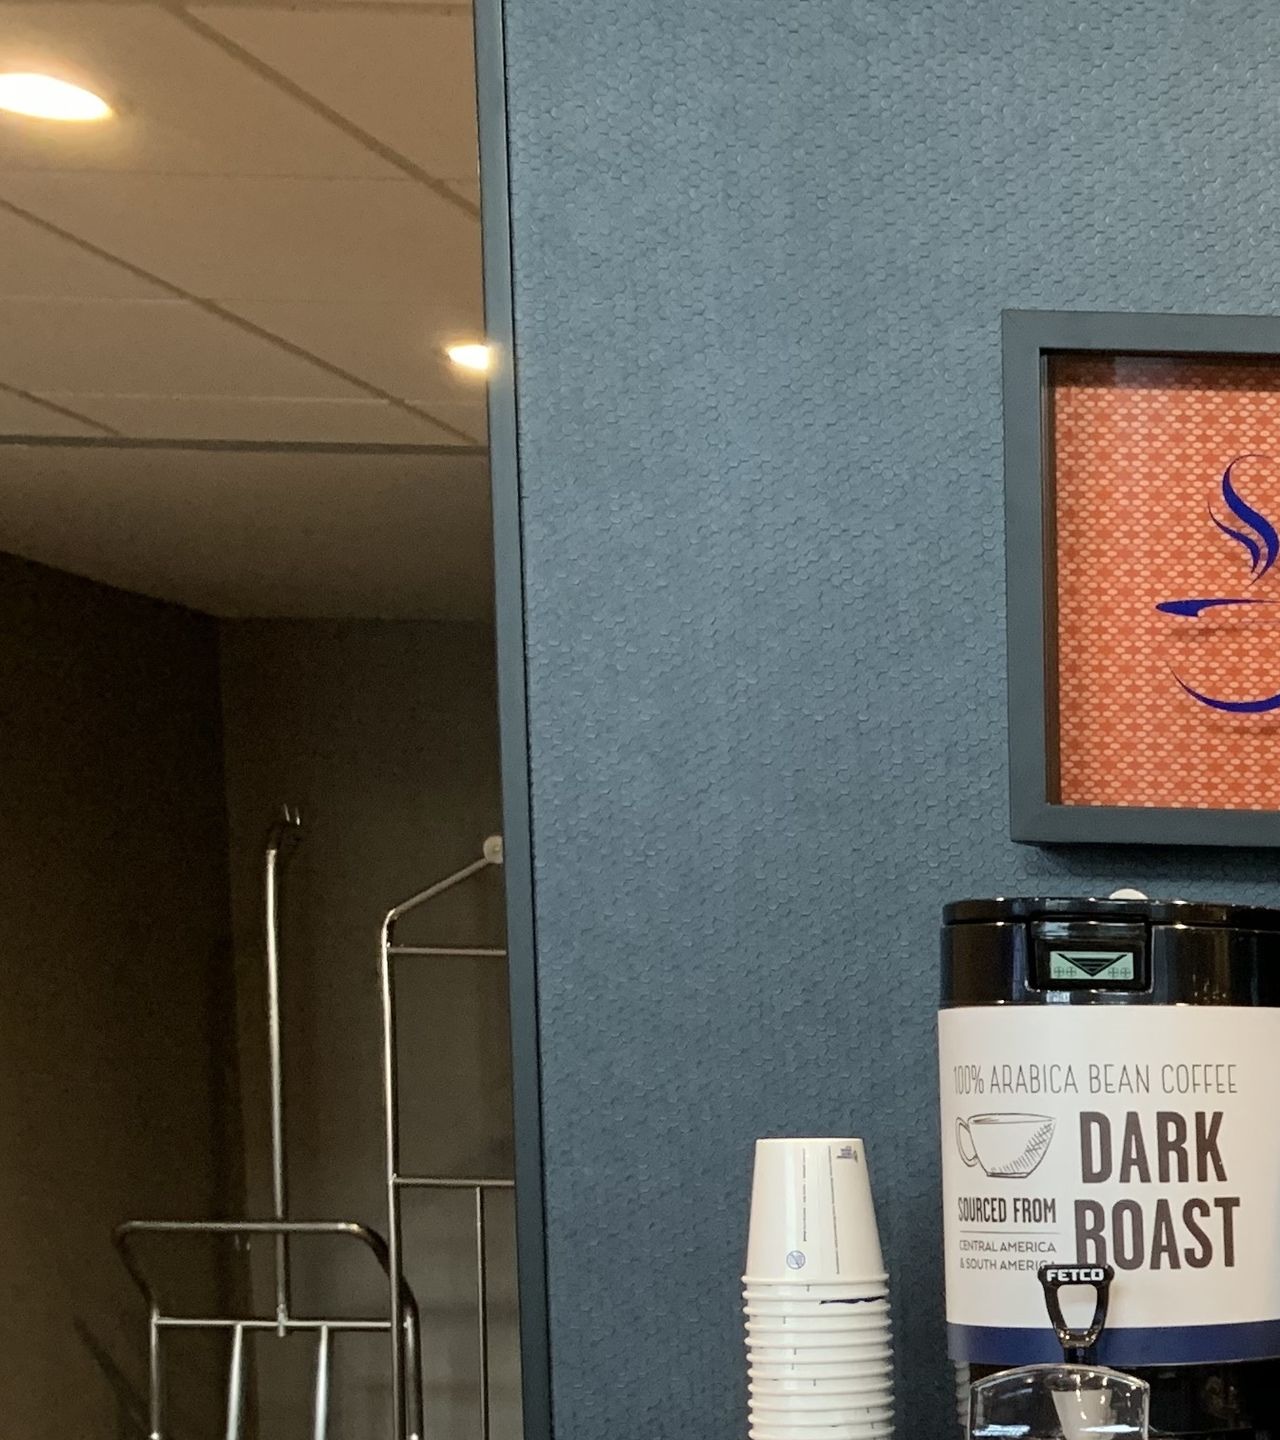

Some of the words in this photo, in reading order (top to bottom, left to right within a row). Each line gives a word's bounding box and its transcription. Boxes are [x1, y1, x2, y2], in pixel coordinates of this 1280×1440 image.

[953, 1065, 985, 1096] 100%
[990, 1064, 1079, 1094] ARABICA
[1089, 1064, 1150, 1094] BEAN
[1161, 1064, 1238, 1094] COFFEE
[1079, 1111, 1228, 1184] DARK
[958, 1197, 1007, 1224] SOURCED
[1013, 1198, 1057, 1224] FROM
[959, 1240, 998, 1252] CENTRAL
[999, 1241, 1057, 1253] AMERICA
[1074, 1197, 1240, 1270] ROAST
[966, 1258, 997, 1271] SOUTH
[1046, 1268, 1104, 1282] FETCO
